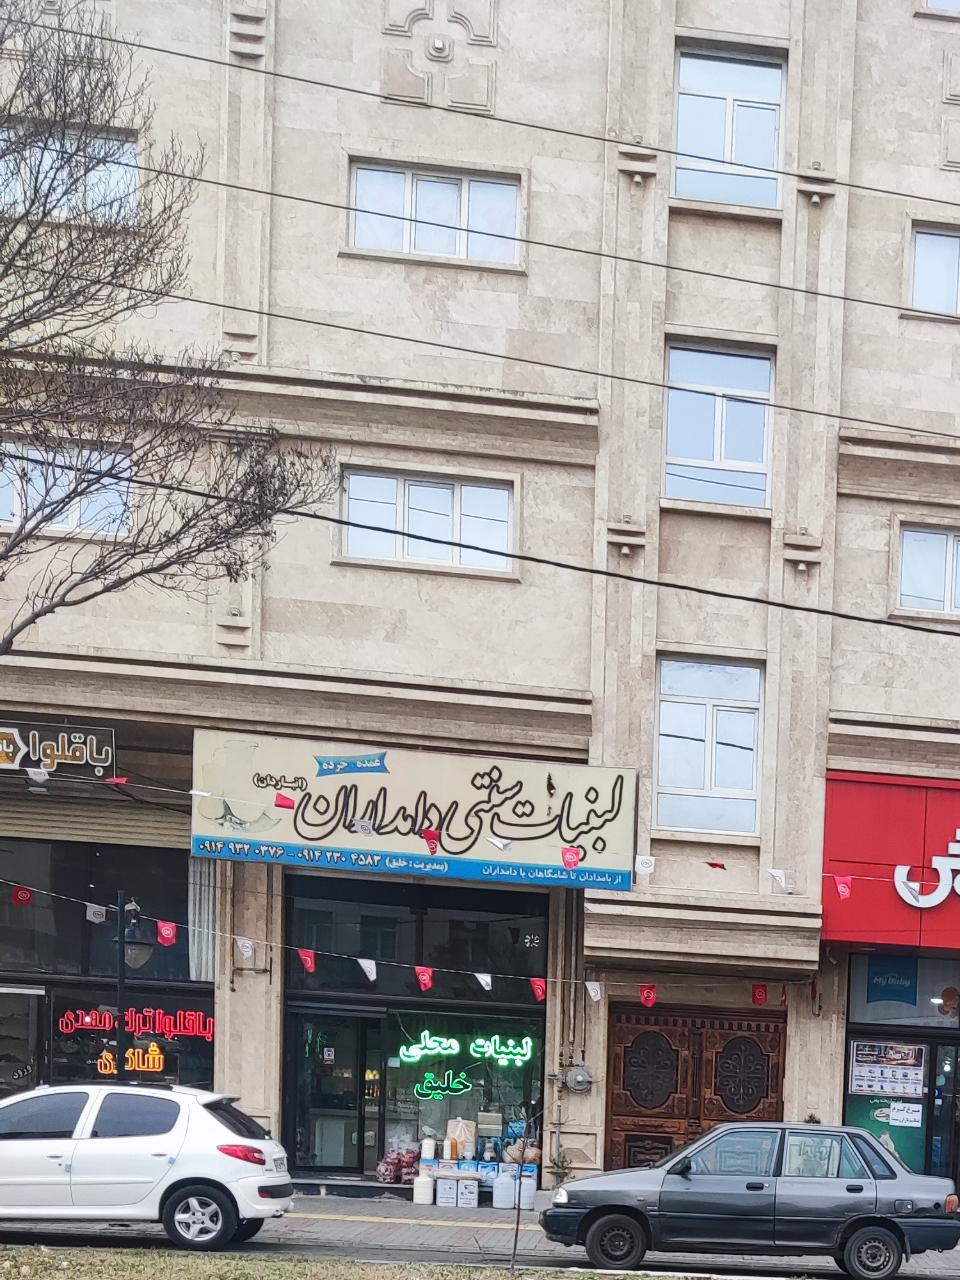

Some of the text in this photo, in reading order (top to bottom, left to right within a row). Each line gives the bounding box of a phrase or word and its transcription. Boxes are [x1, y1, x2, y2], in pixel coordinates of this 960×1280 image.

[29, 730, 112, 777] باقلوا
[294, 765, 624, 862] لبنیات سنتی دامداران
[482, 865, 518, 877] دامداران
[527, 867, 569, 880] شامگاهان
[579, 872, 612, 884] بامدادان
[613, 875, 622, 885] از
[156, 1008, 214, 1041] باقلوا
[400, 1029, 533, 1067] لبنیات محلی
[414, 1070, 473, 1100] خلیق
